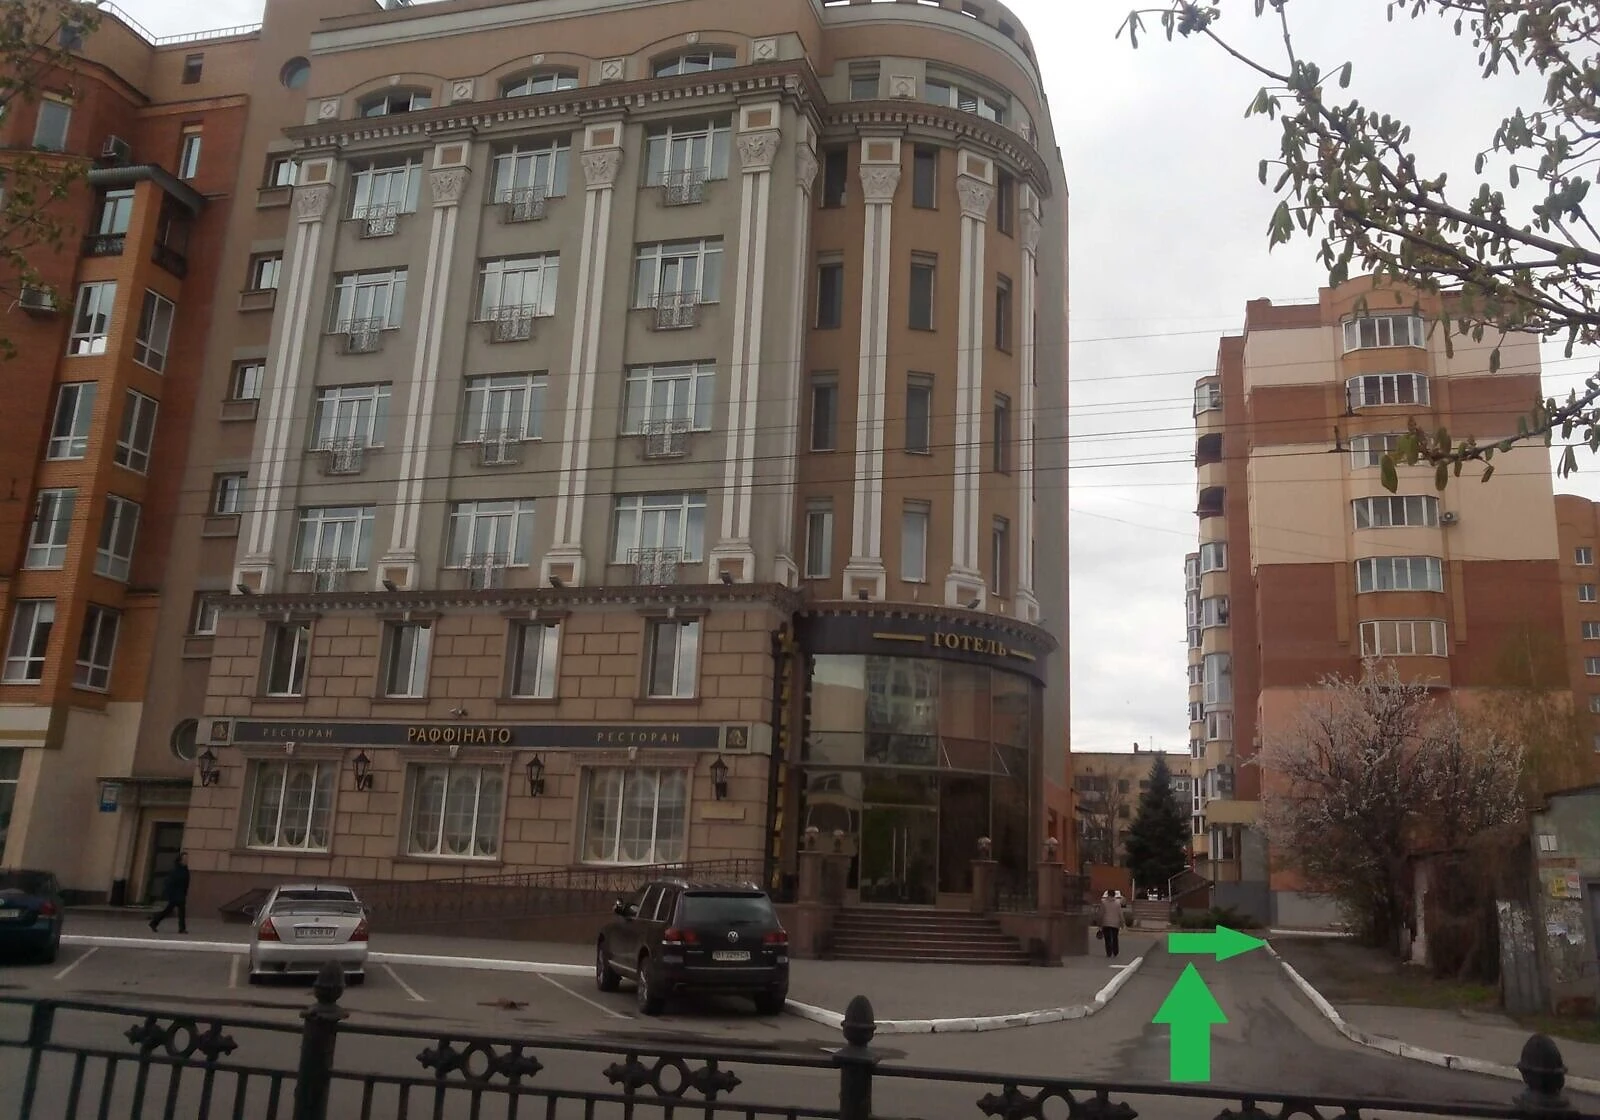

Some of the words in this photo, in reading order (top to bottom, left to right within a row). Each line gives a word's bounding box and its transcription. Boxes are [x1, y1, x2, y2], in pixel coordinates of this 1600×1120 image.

[934, 632, 1006, 657] ГОТЕЛЬ
[263, 728, 334, 739] РЕСТОРАН
[407, 727, 511, 744] РАФФІНАТО
[597, 731, 680, 743] РЕСТОРАН
